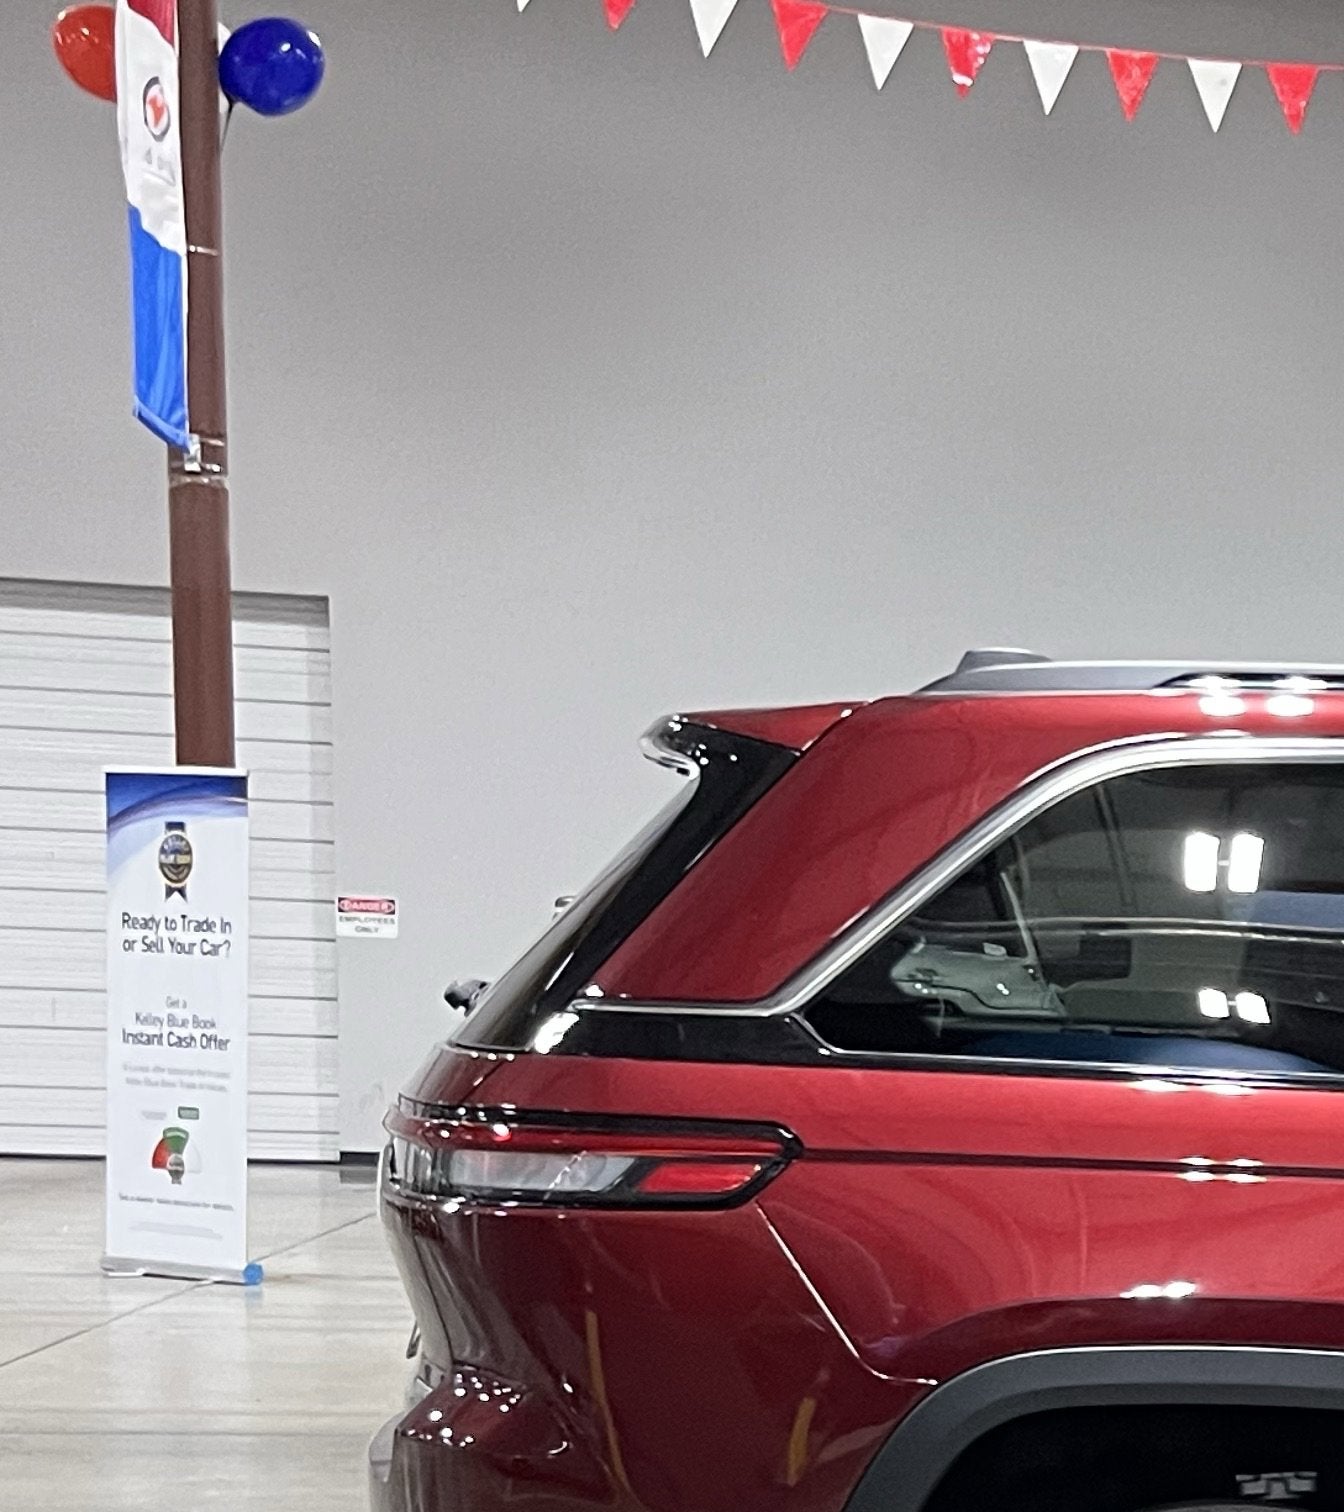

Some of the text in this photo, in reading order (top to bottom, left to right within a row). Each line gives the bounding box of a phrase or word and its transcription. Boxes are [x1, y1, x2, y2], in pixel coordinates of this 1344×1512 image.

[121, 912, 232, 936] Ready to Trade In
[122, 935, 232, 958] or Sell Your Car?
[122, 1028, 230, 1051] Instant Cash Offer
